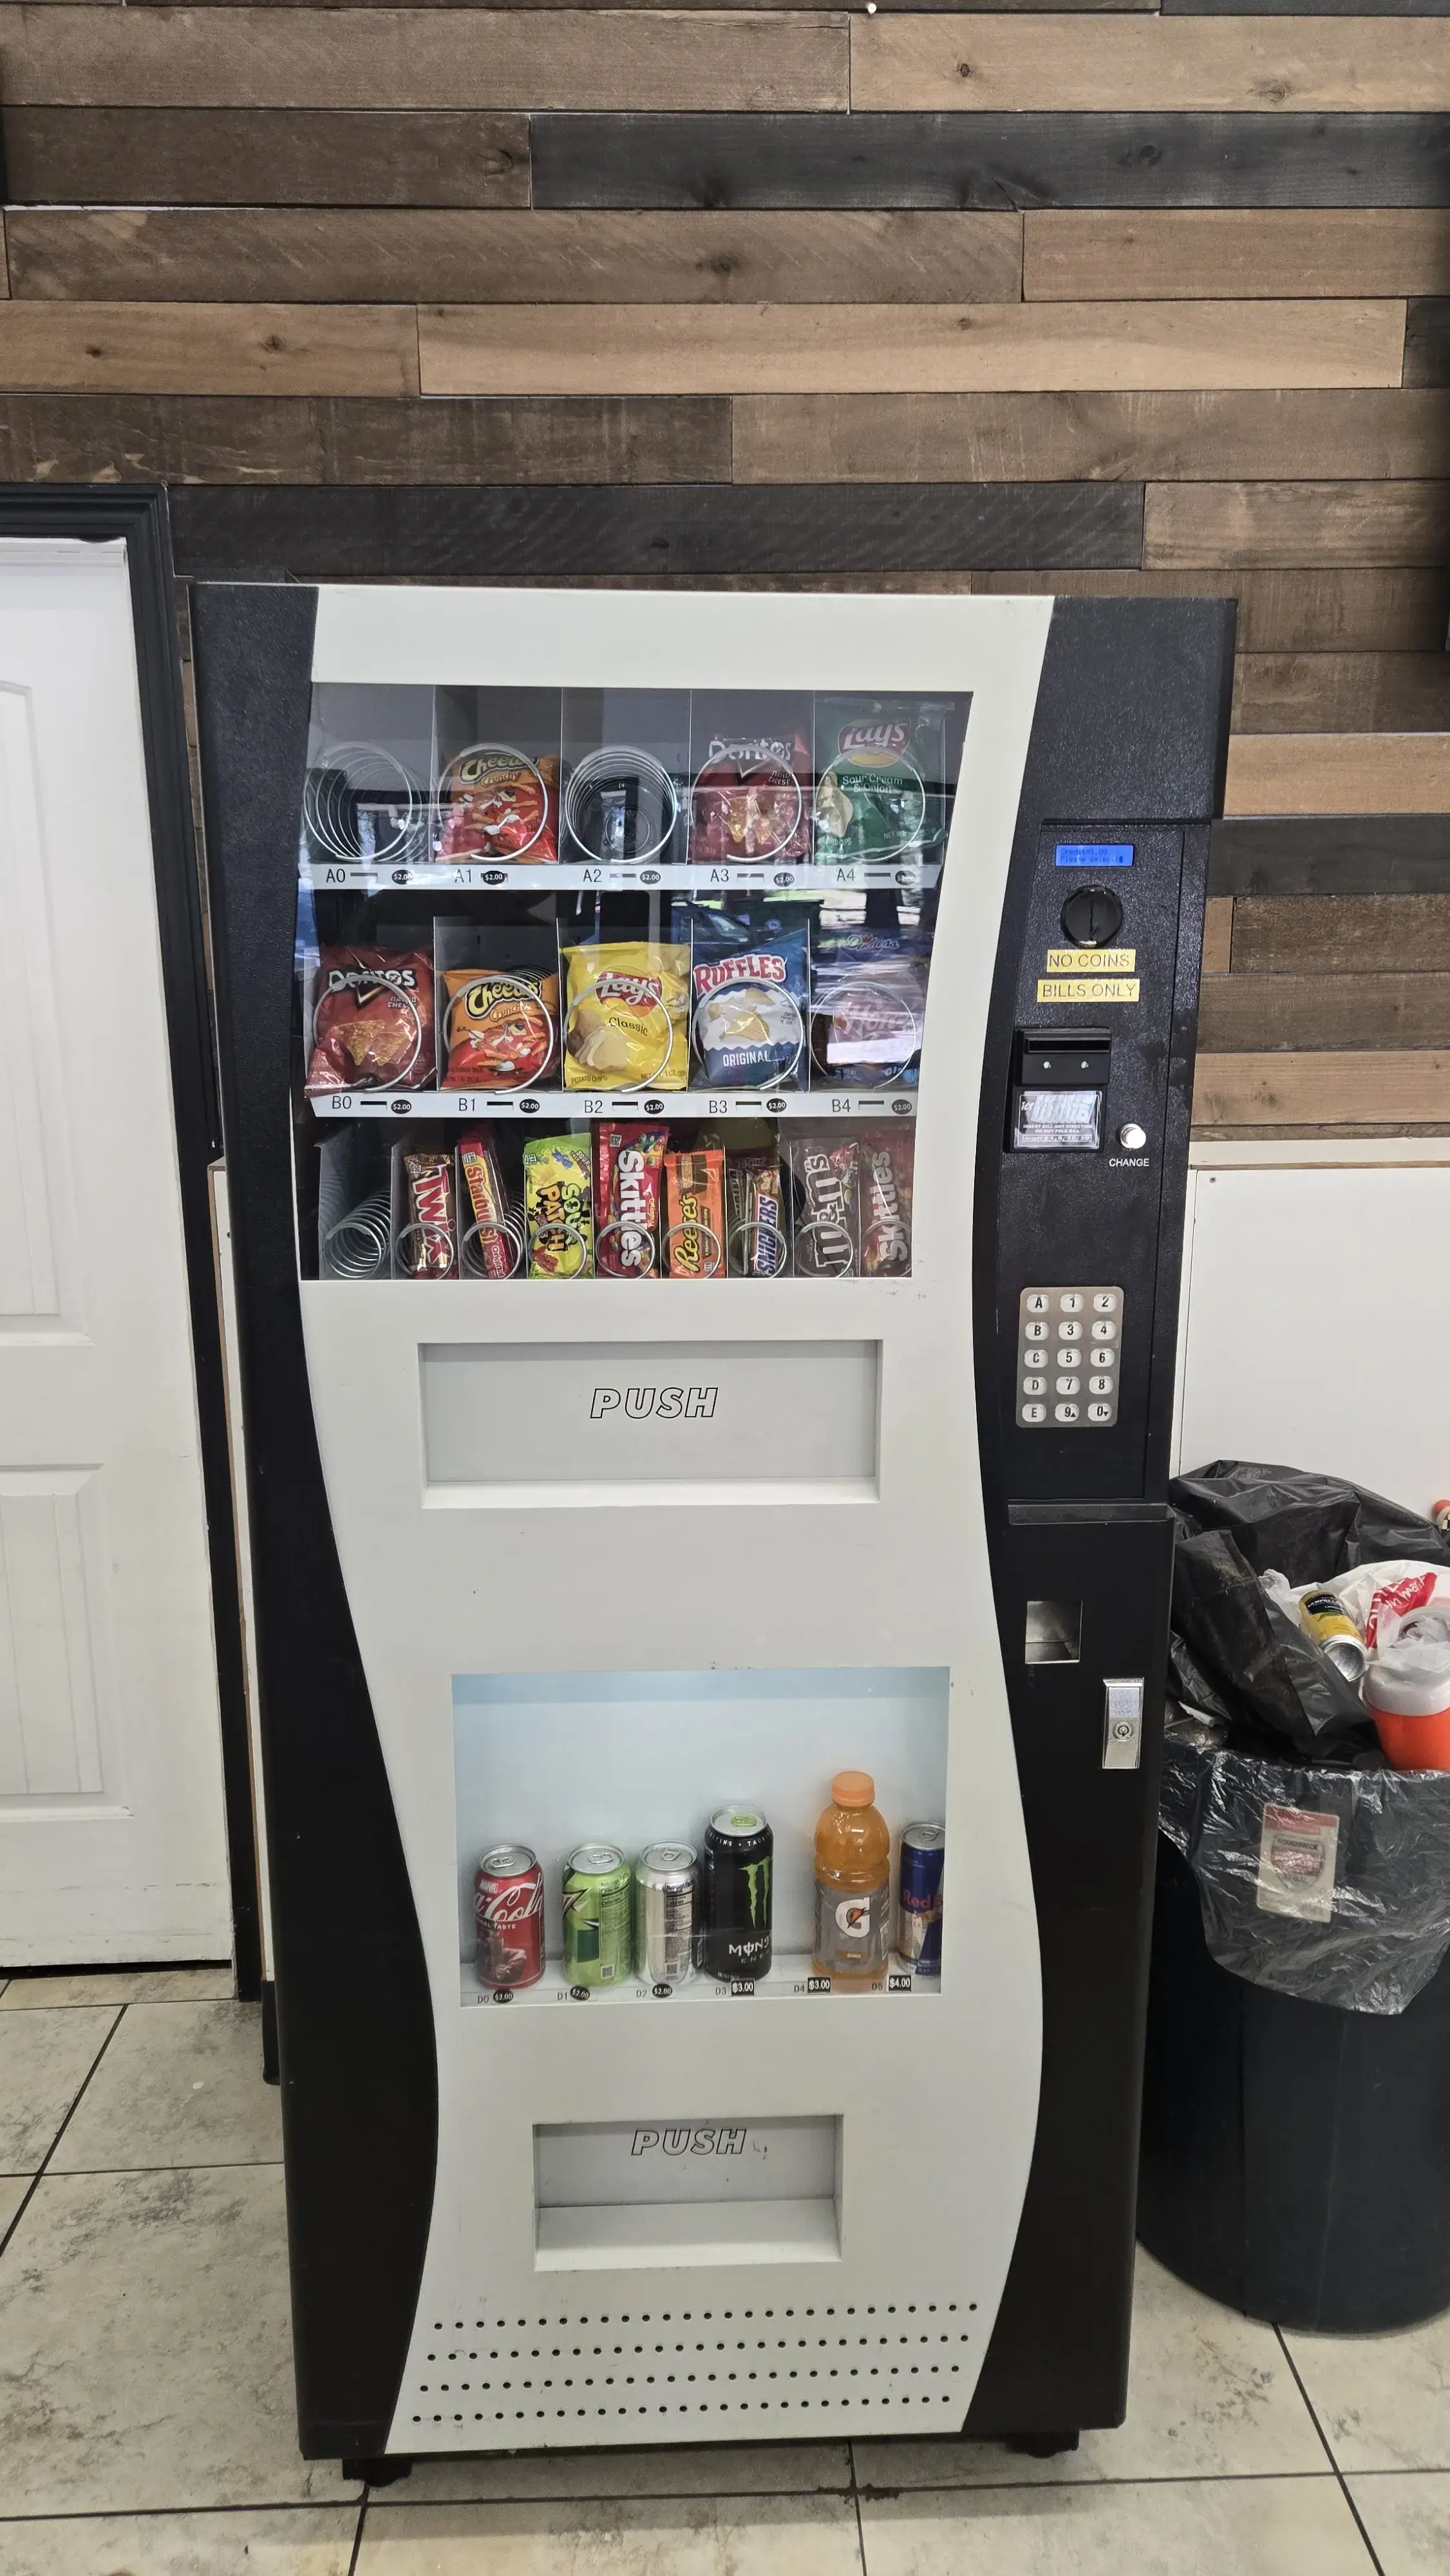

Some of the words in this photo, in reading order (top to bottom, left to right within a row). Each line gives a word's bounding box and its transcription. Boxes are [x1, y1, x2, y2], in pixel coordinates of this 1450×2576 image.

[842, 773, 866, 786] Sour
[869, 773, 903, 786] Cream
[864, 782, 892, 793] Onion
[326, 868, 346, 883] A0
[455, 868, 471, 883] A1
[583, 869, 602, 882] A2
[710, 869, 729, 882] A3
[836, 868, 856, 882] A4
[1049, 954, 1072, 967] NO
[1078, 953, 1129, 967] COINS
[693, 955, 785, 996] RUFFLES
[1042, 983, 1086, 998] BILLS
[1091, 983, 1136, 997] ONLY
[608, 1017, 648, 1037] Classic
[722, 1050, 771, 1067] ORIGINAL
[571, 1074, 591, 1084] POTATO
[332, 1095, 352, 1110] B0
[393, 1103, 411, 1111] $2.00
[459, 1097, 476, 1112] B1
[521, 1102, 539, 1110] $2.00
[584, 1099, 603, 1113] B2
[709, 1100, 728, 1113] B3
[769, 1101, 786, 1110] $2.00
[832, 1099, 851, 1113] B4
[894, 1103, 911, 1112] $2.00
[576, 1150, 591, 1167] SOUR
[1109, 1158, 1149, 1167] CHANGE
[466, 1166, 498, 1244] Starbust
[618, 1150, 648, 1267] Skittles
[870, 1151, 908, 1262] Skittles
[491, 1245, 505, 1278] Original
[1035, 1297, 1042, 1308] A
[1070, 1297, 1075, 1307] 1
[1102, 1296, 1109, 1307] 2
[1034, 1325, 1041, 1336] B
[1067, 1325, 1074, 1336] 3
[1100, 1324, 1107, 1335] 4
[1033, 1353, 1040, 1363] C
[1066, 1352, 1072, 1363] 5
[1099, 1352, 1106, 1363] 6
[1032, 1380, 1039, 1390] D
[1066, 1378, 1073, 1390] 7
[1098, 1379, 1105, 1390] 8
[590, 1387, 718, 1419] PUSH
[1031, 1408, 1037, 1417] E
[1064, 1406, 1071, 1417] 9
[1097, 1406, 1103, 1417] 0
[479, 1878, 498, 1894] MARVEL
[904, 1889, 932, 1909] Red
[835, 1897, 870, 1938] G
[732, 1982, 754, 1993] $3.00
[794, 1985, 805, 1993] D4
[809, 1980, 831, 1991] $3.00
[889, 1977, 910, 1989] $4.00
[478, 1995, 489, 2004] D0
[494, 1993, 513, 2001] $2.00
[557, 1991, 568, 2000] D1
[571, 1987, 589, 1999] $2.00
[636, 1989, 647, 1998] D2
[654, 1987, 672, 1995] $2.00
[631, 2128, 747, 2156] PUSH
